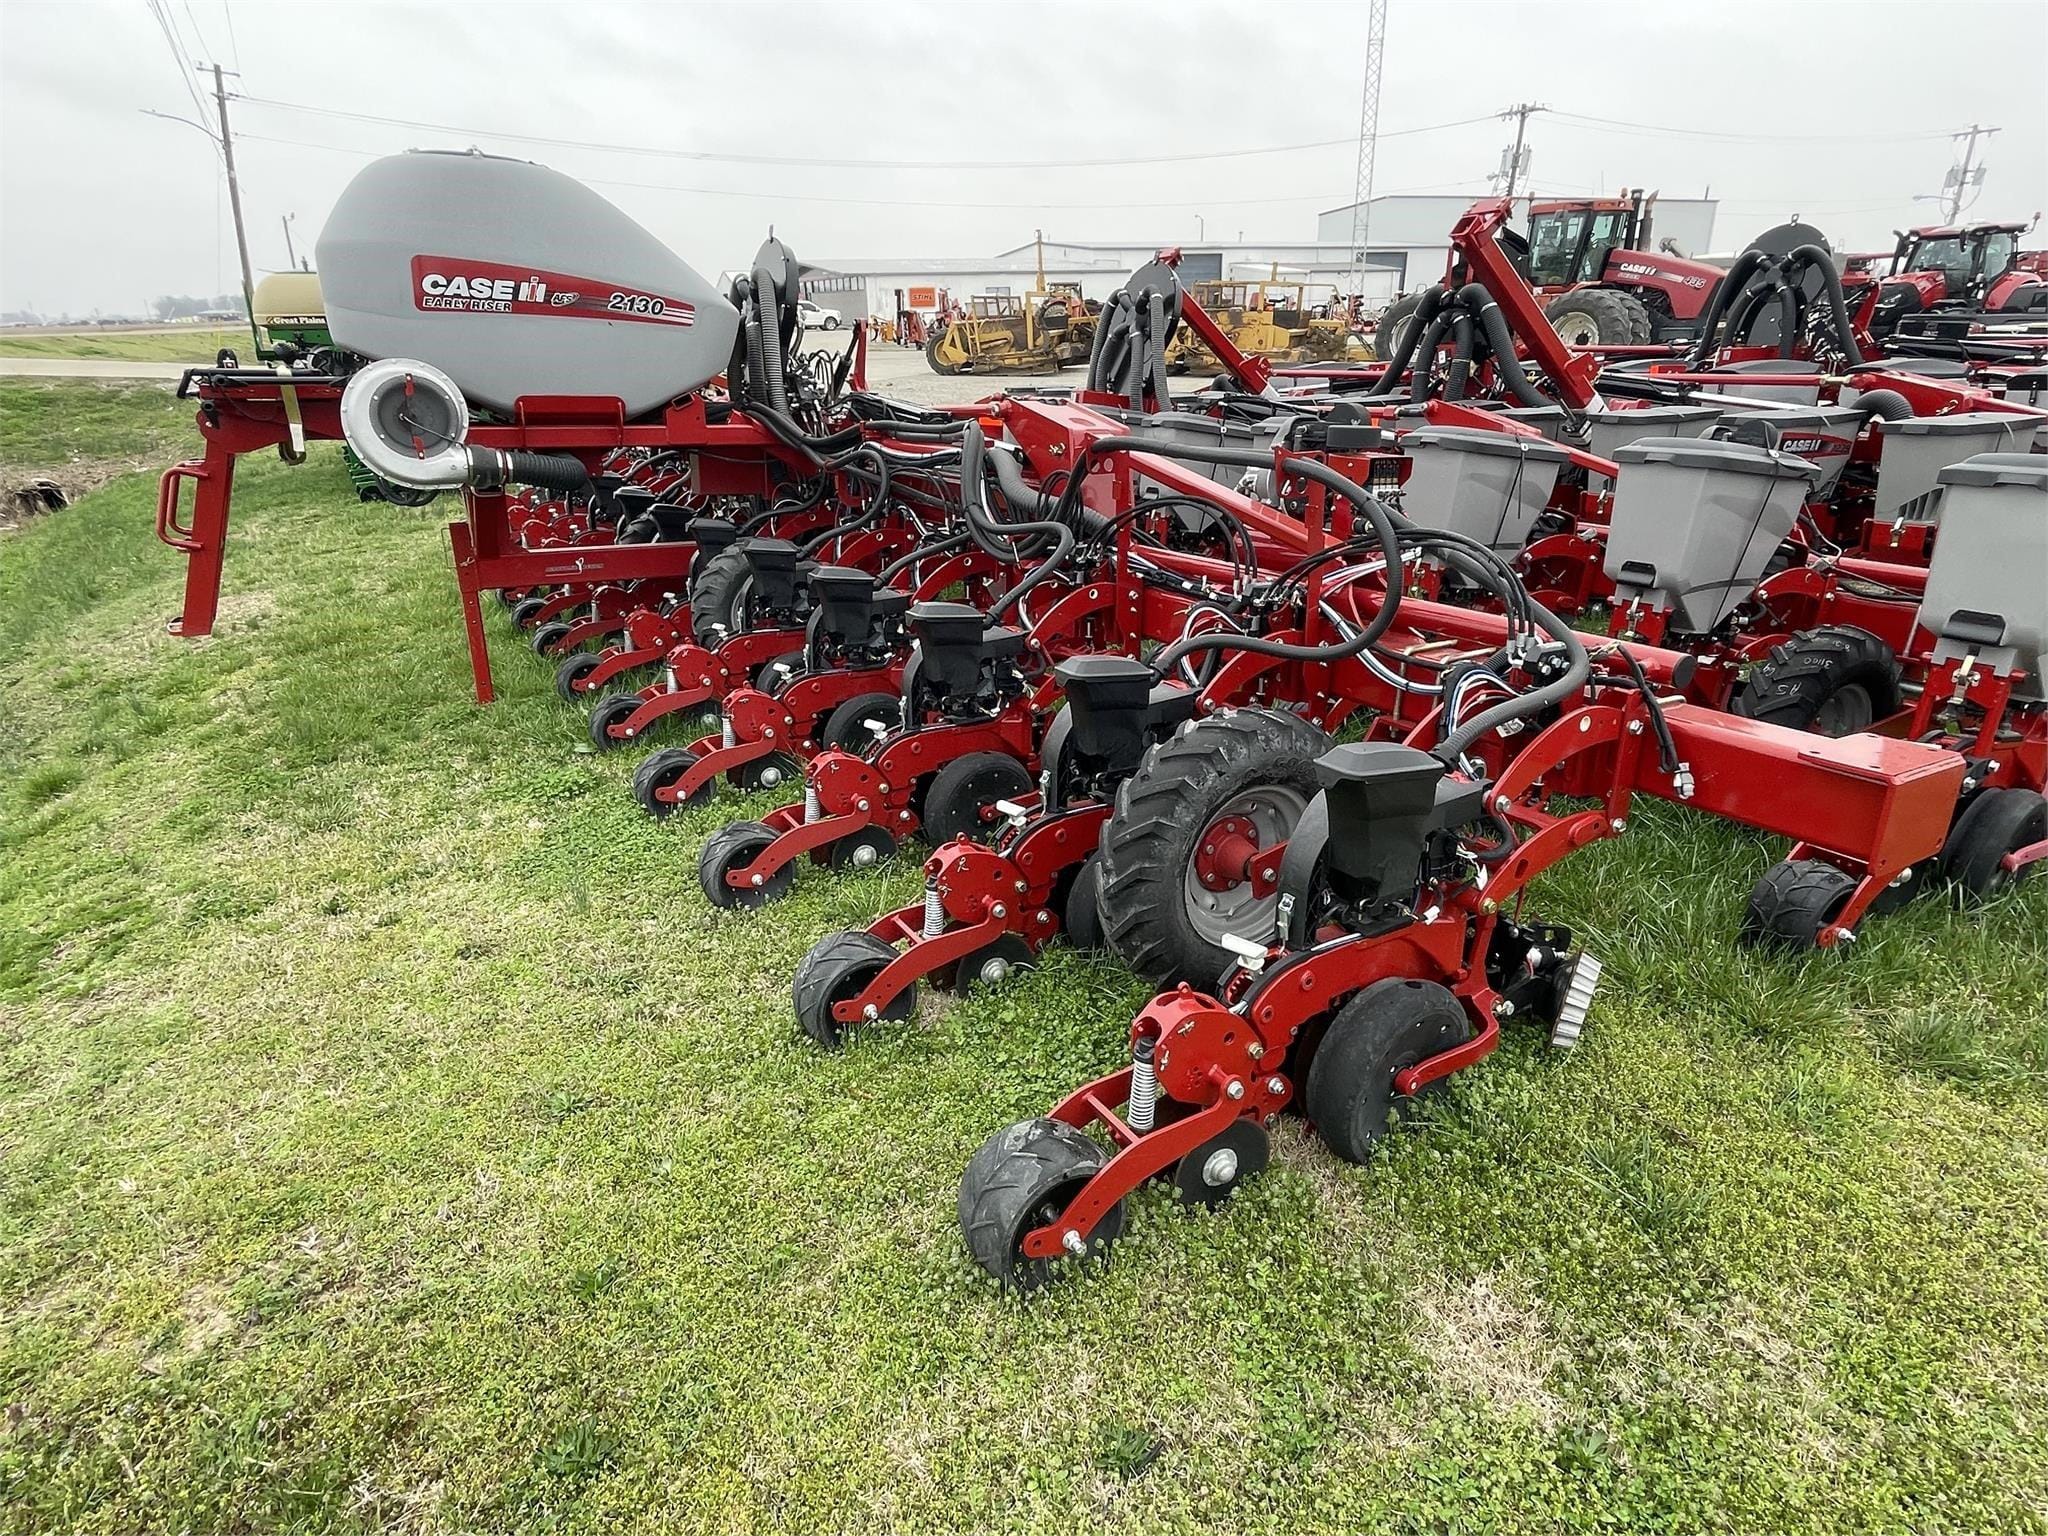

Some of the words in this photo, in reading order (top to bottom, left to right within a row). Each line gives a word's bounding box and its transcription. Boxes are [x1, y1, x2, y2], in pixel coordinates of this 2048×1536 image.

[1620, 263, 1645, 274] CASE
[421, 273, 514, 301] CASE
[608, 293, 665, 316] 2130
[422, 297, 470, 311] EARLY
[471, 300, 513, 312] RISER
[273, 316, 298, 324] Great
[299, 316, 326, 324] Plains
[1782, 440, 1811, 452] CASE
